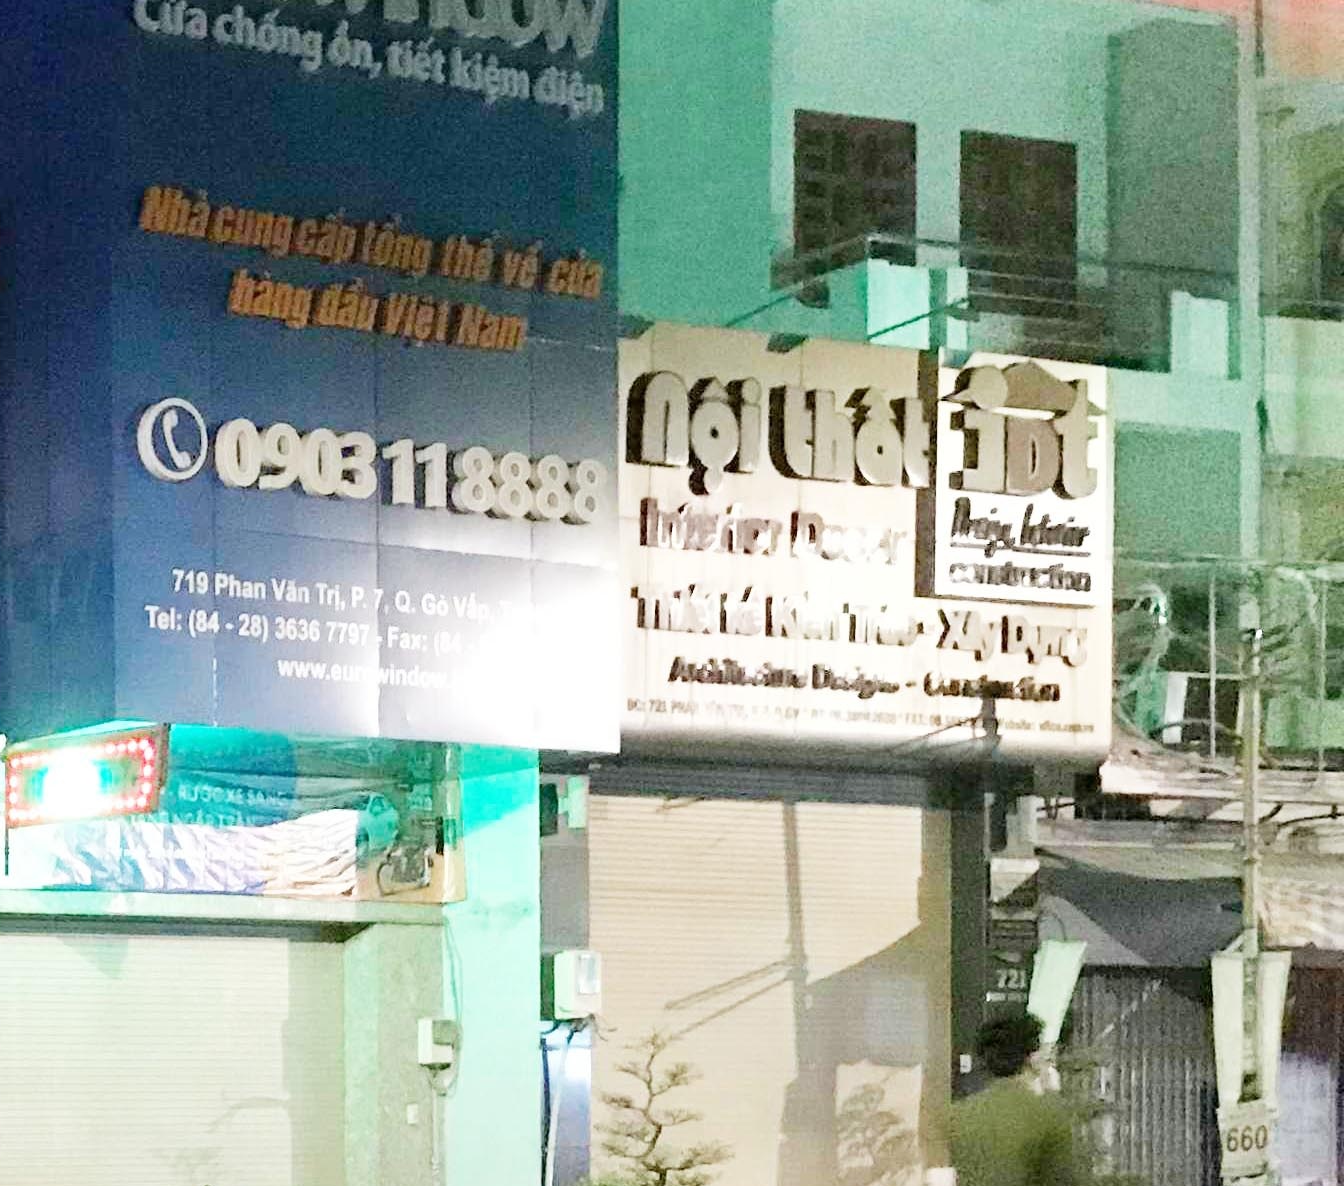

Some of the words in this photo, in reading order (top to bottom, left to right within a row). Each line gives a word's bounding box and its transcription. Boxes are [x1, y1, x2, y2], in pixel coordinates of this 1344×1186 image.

[213, 8, 323, 73] chống
[454, 303, 528, 351] Nam
[172, 568, 209, 595] 719
[214, 572, 267, 600] Phan
[271, 578, 311, 604] Văn
[421, 592, 450, 617] Gò
[144, 605, 182, 631] Tel:
[188, 609, 220, 638] (84
[238, 613, 269, 643] 28)
[274, 615, 321, 642] 3636
[326, 621, 370, 646] 7797
[1226, 1122, 1269, 1155] 660
